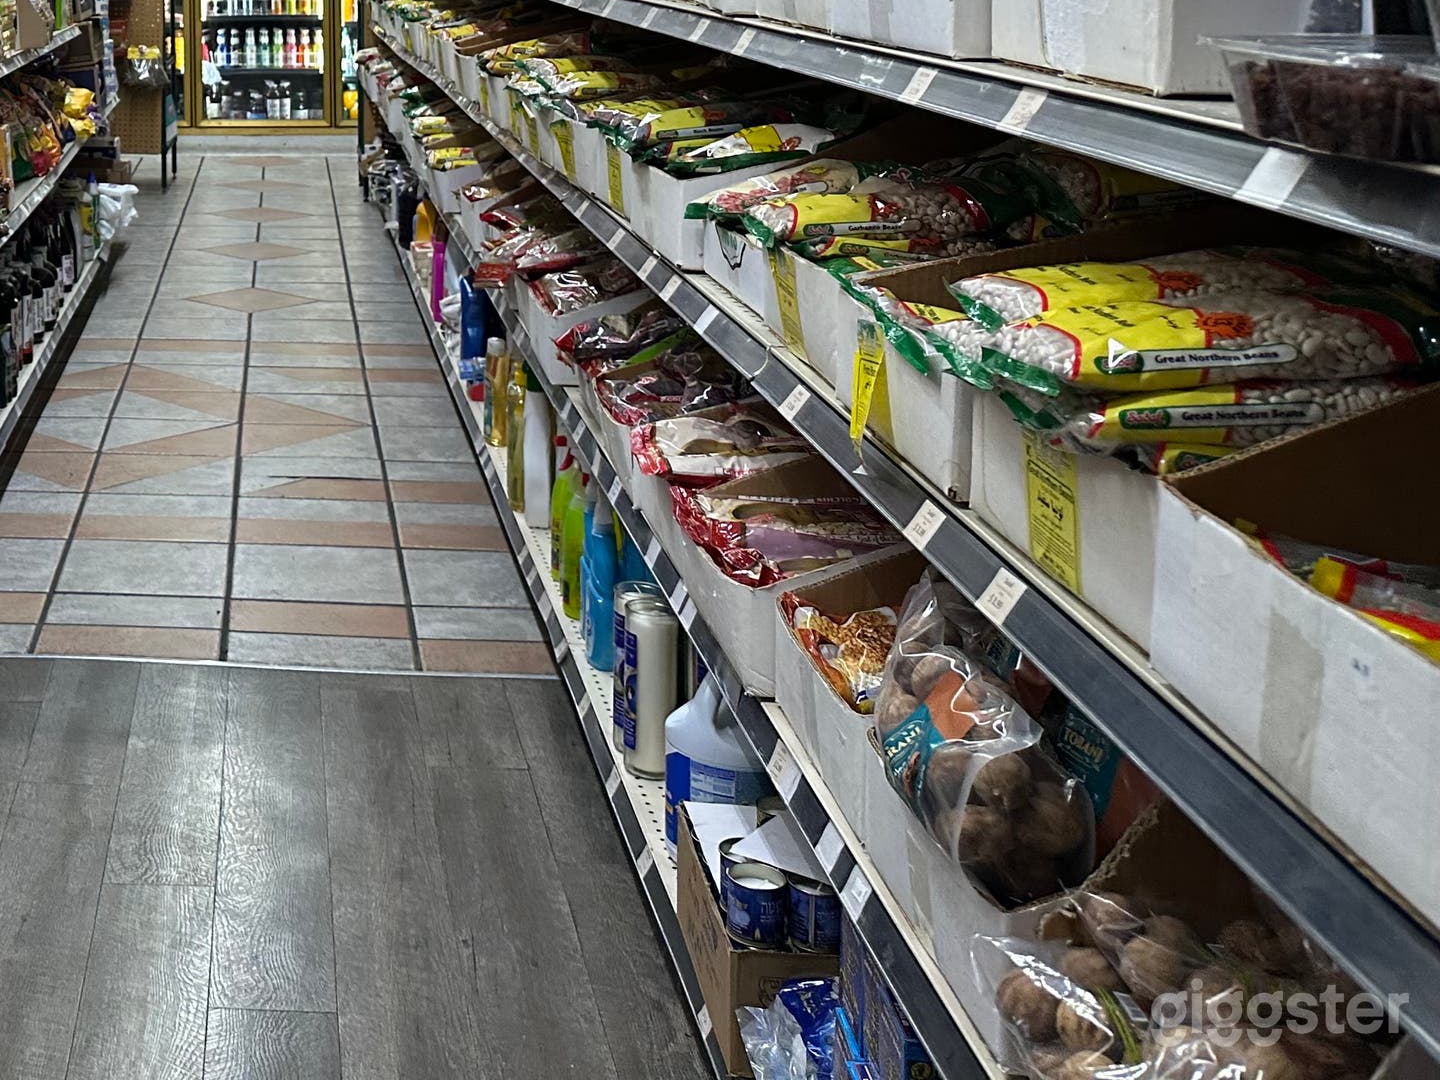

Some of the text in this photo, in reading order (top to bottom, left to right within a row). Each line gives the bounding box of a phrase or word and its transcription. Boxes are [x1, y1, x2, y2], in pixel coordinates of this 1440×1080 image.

[1154, 350, 1280, 364] Great Northern Beans
[1182, 408, 1307, 421] Great Northern Beans
